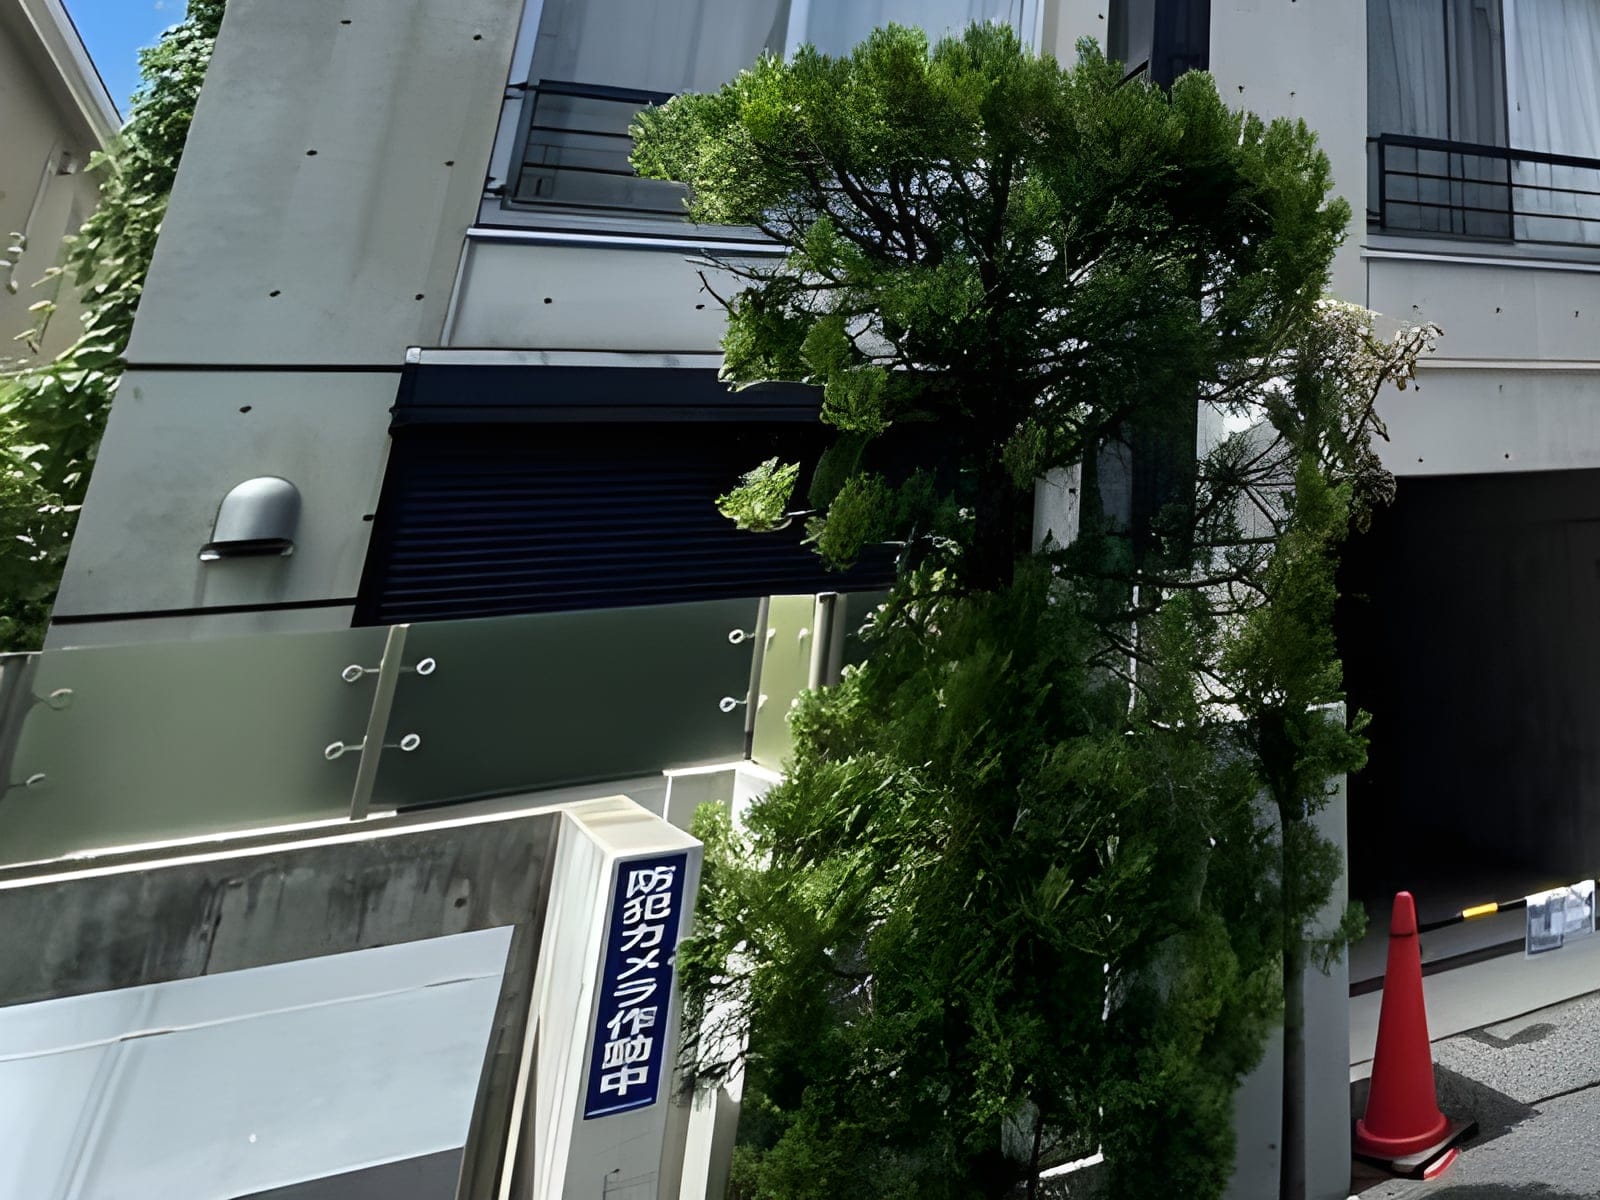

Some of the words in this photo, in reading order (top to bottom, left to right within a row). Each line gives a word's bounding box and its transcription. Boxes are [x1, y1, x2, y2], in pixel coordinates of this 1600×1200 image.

[600, 865, 676, 1096] 防犯カメラ作動中
